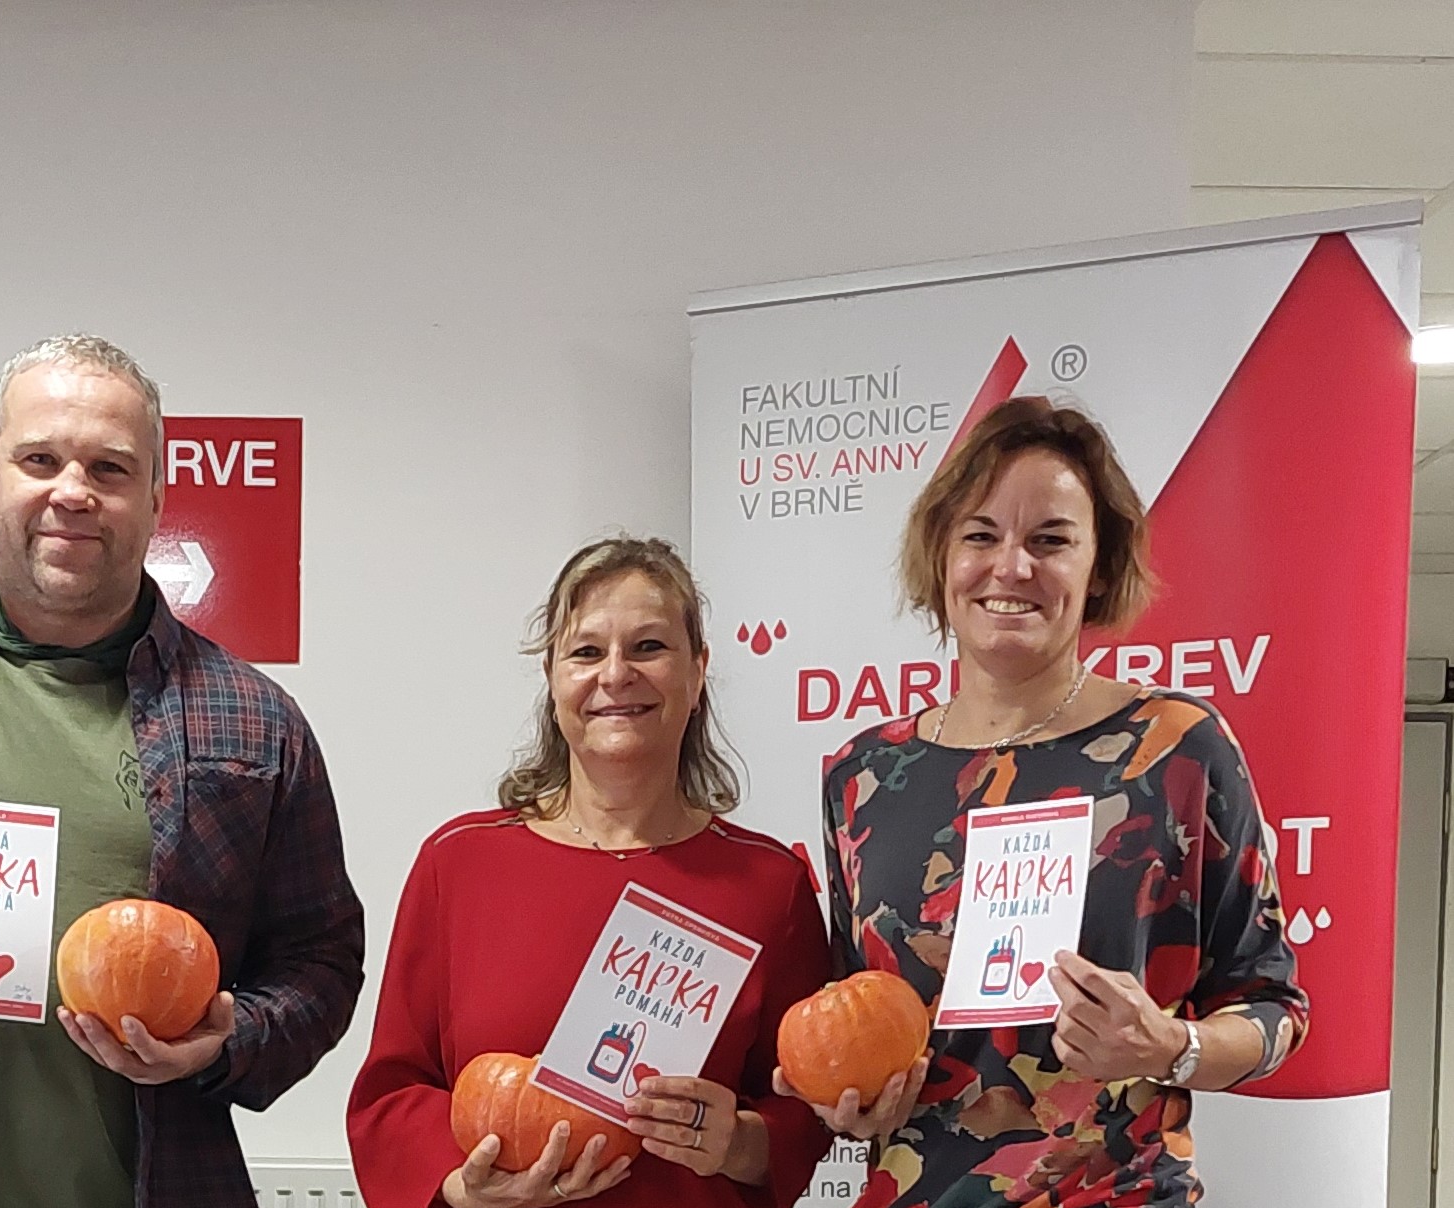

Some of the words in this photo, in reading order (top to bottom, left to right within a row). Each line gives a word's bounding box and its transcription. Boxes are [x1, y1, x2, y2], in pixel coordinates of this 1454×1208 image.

[741, 365, 902, 415] FAKULTNÍ
[739, 402, 951, 450] NEMOCNICE
[739, 457, 762, 486] U
[772, 450, 822, 482] SV.
[830, 440, 930, 478] ANNY
[739, 492, 762, 521] V
[770, 479, 865, 519] BRNĚ
[797, 658, 961, 723] DAR
[1002, 830, 1052, 854] KAŽDÁ
[972, 854, 1074, 903] KAPKA
[988, 896, 1051, 919] POMÁHÁ
[648, 929, 707, 969] KAŽDÁ
[601, 935, 720, 1024] KAPKA
[614, 984, 685, 1029] POMÁHÁ
[821, 1181, 851, 1198] na
